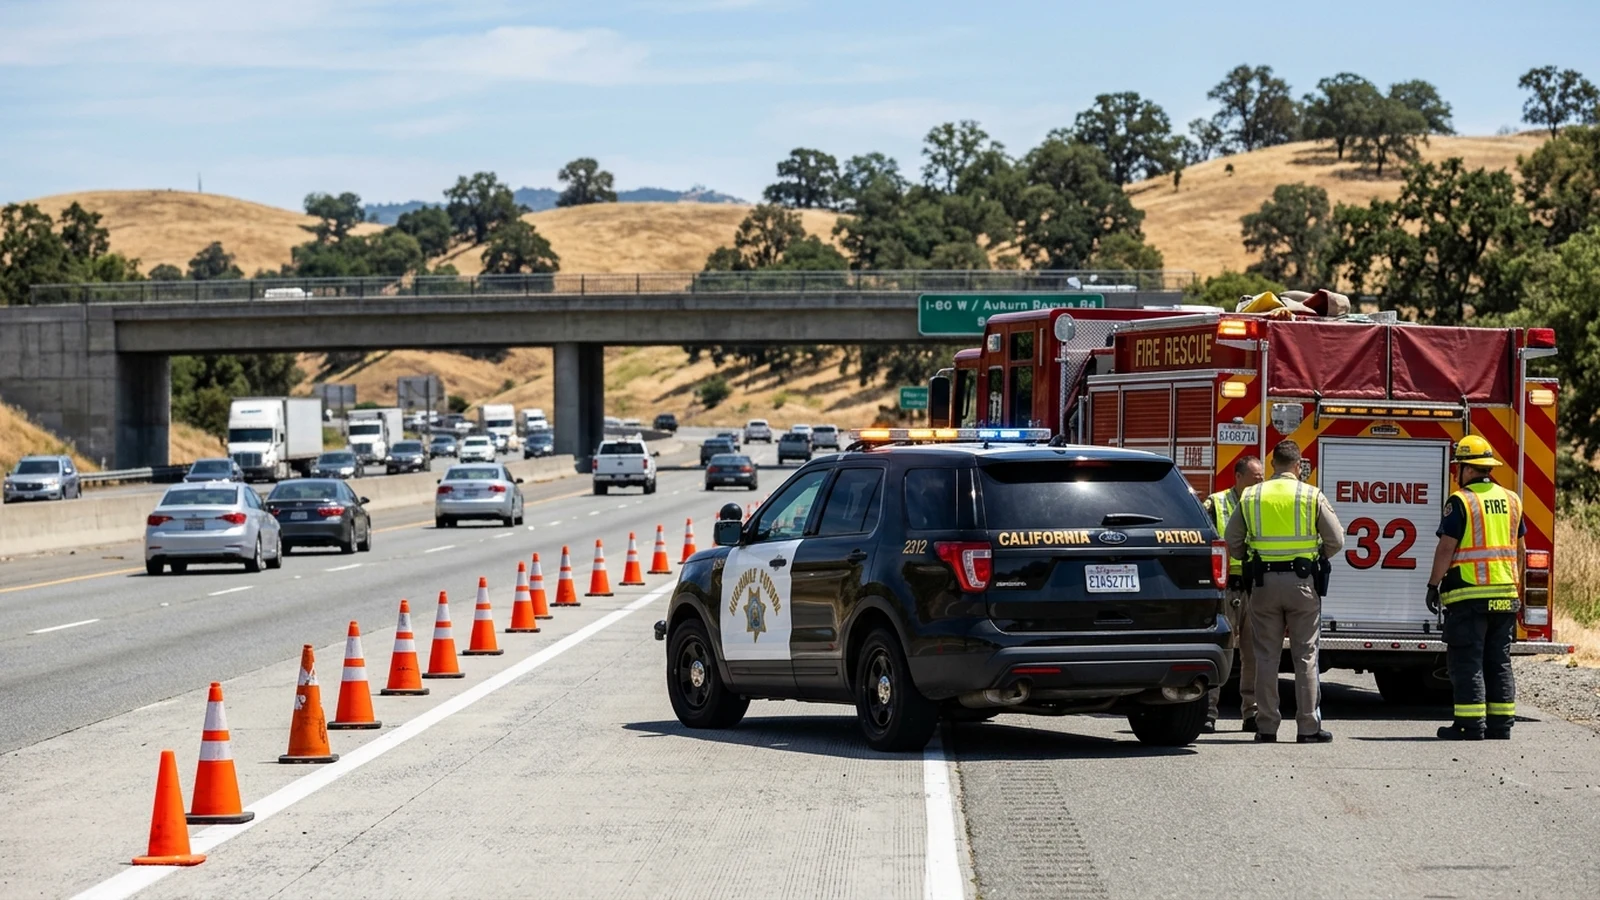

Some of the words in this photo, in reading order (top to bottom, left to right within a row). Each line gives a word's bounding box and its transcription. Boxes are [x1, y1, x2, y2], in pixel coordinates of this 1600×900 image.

[956, 300, 968, 311] W
[1135, 338, 1160, 367] FIRE
[1164, 333, 1213, 366] RESCUE
[1336, 480, 1429, 505] ENGINE
[1483, 499, 1508, 515] FIRE
[999, 529, 1091, 546] CALIFORNIA
[1154, 529, 1206, 545] PATROL
[1345, 516, 1417, 570] 32
[902, 539, 928, 555] 2312
